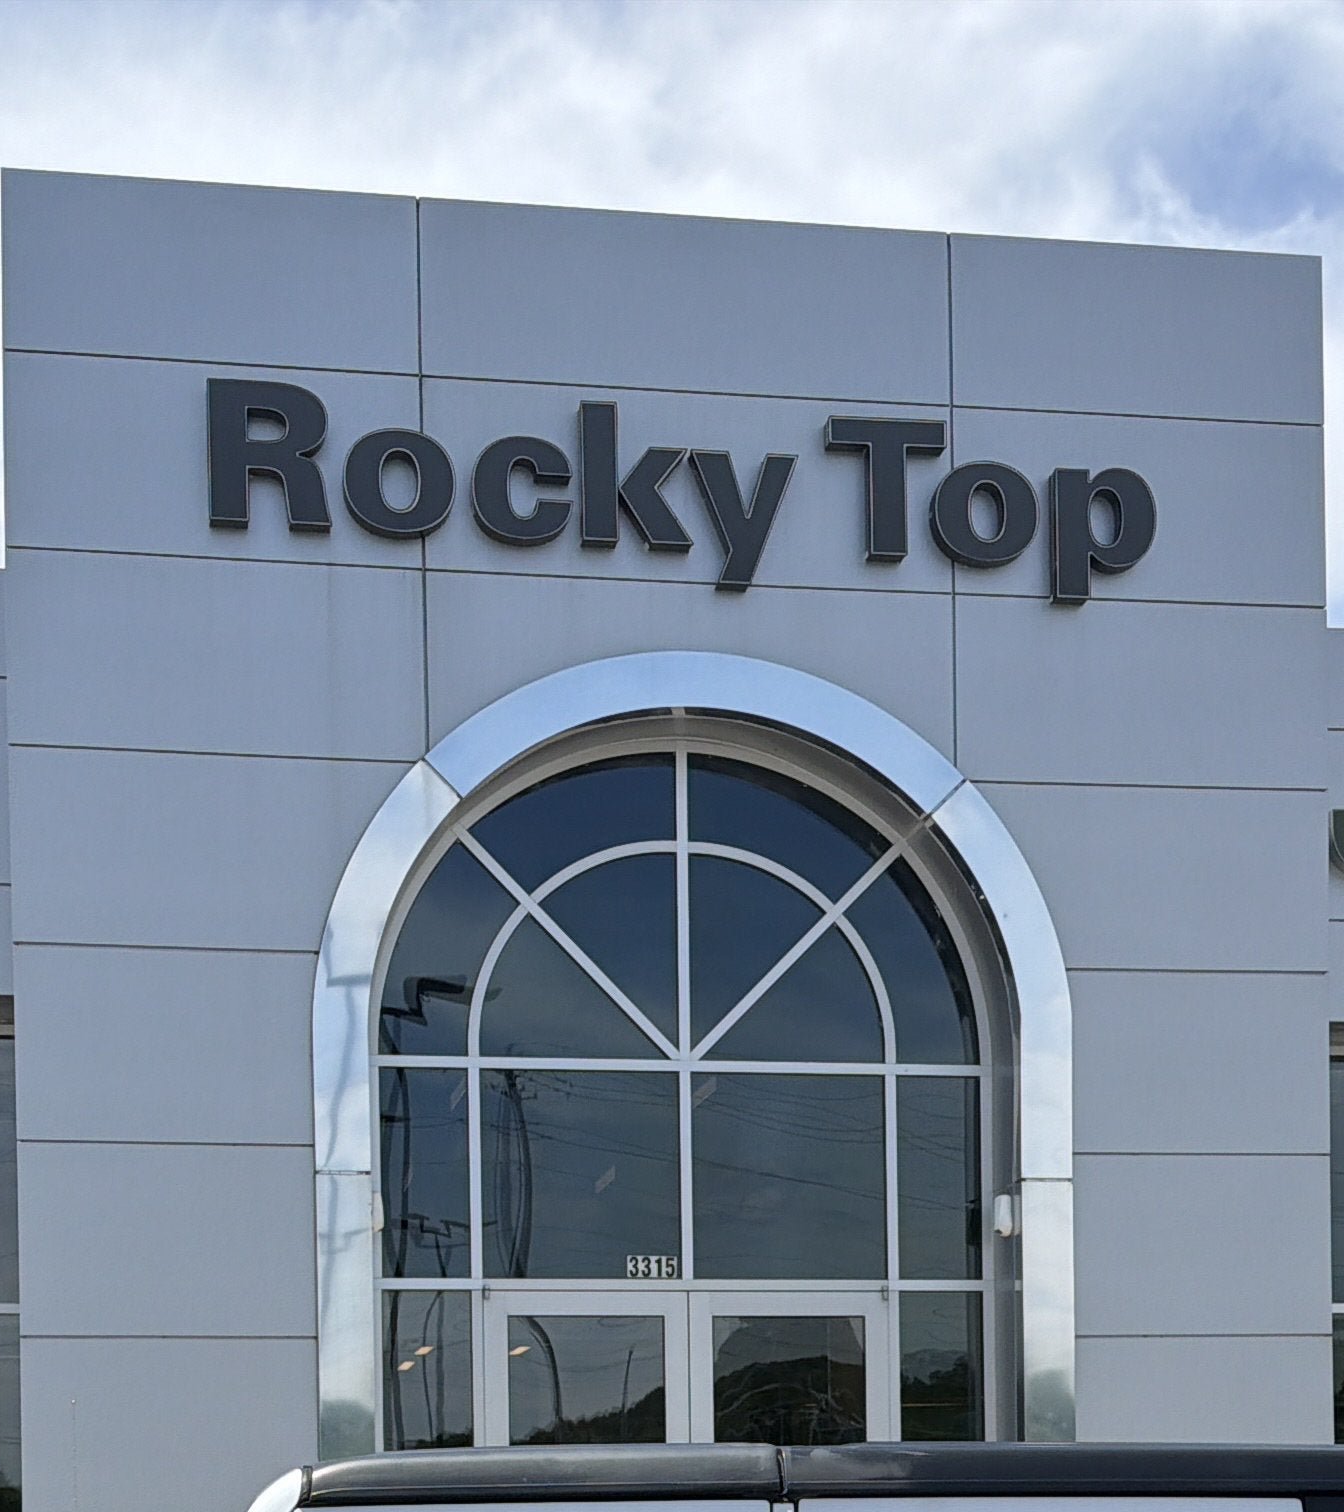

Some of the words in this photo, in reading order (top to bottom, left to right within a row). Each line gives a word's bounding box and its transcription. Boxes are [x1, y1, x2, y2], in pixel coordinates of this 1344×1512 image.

[207, 376, 798, 593] Rocky
[823, 415, 1157, 604] Top
[629, 1256, 676, 1277] 3315
